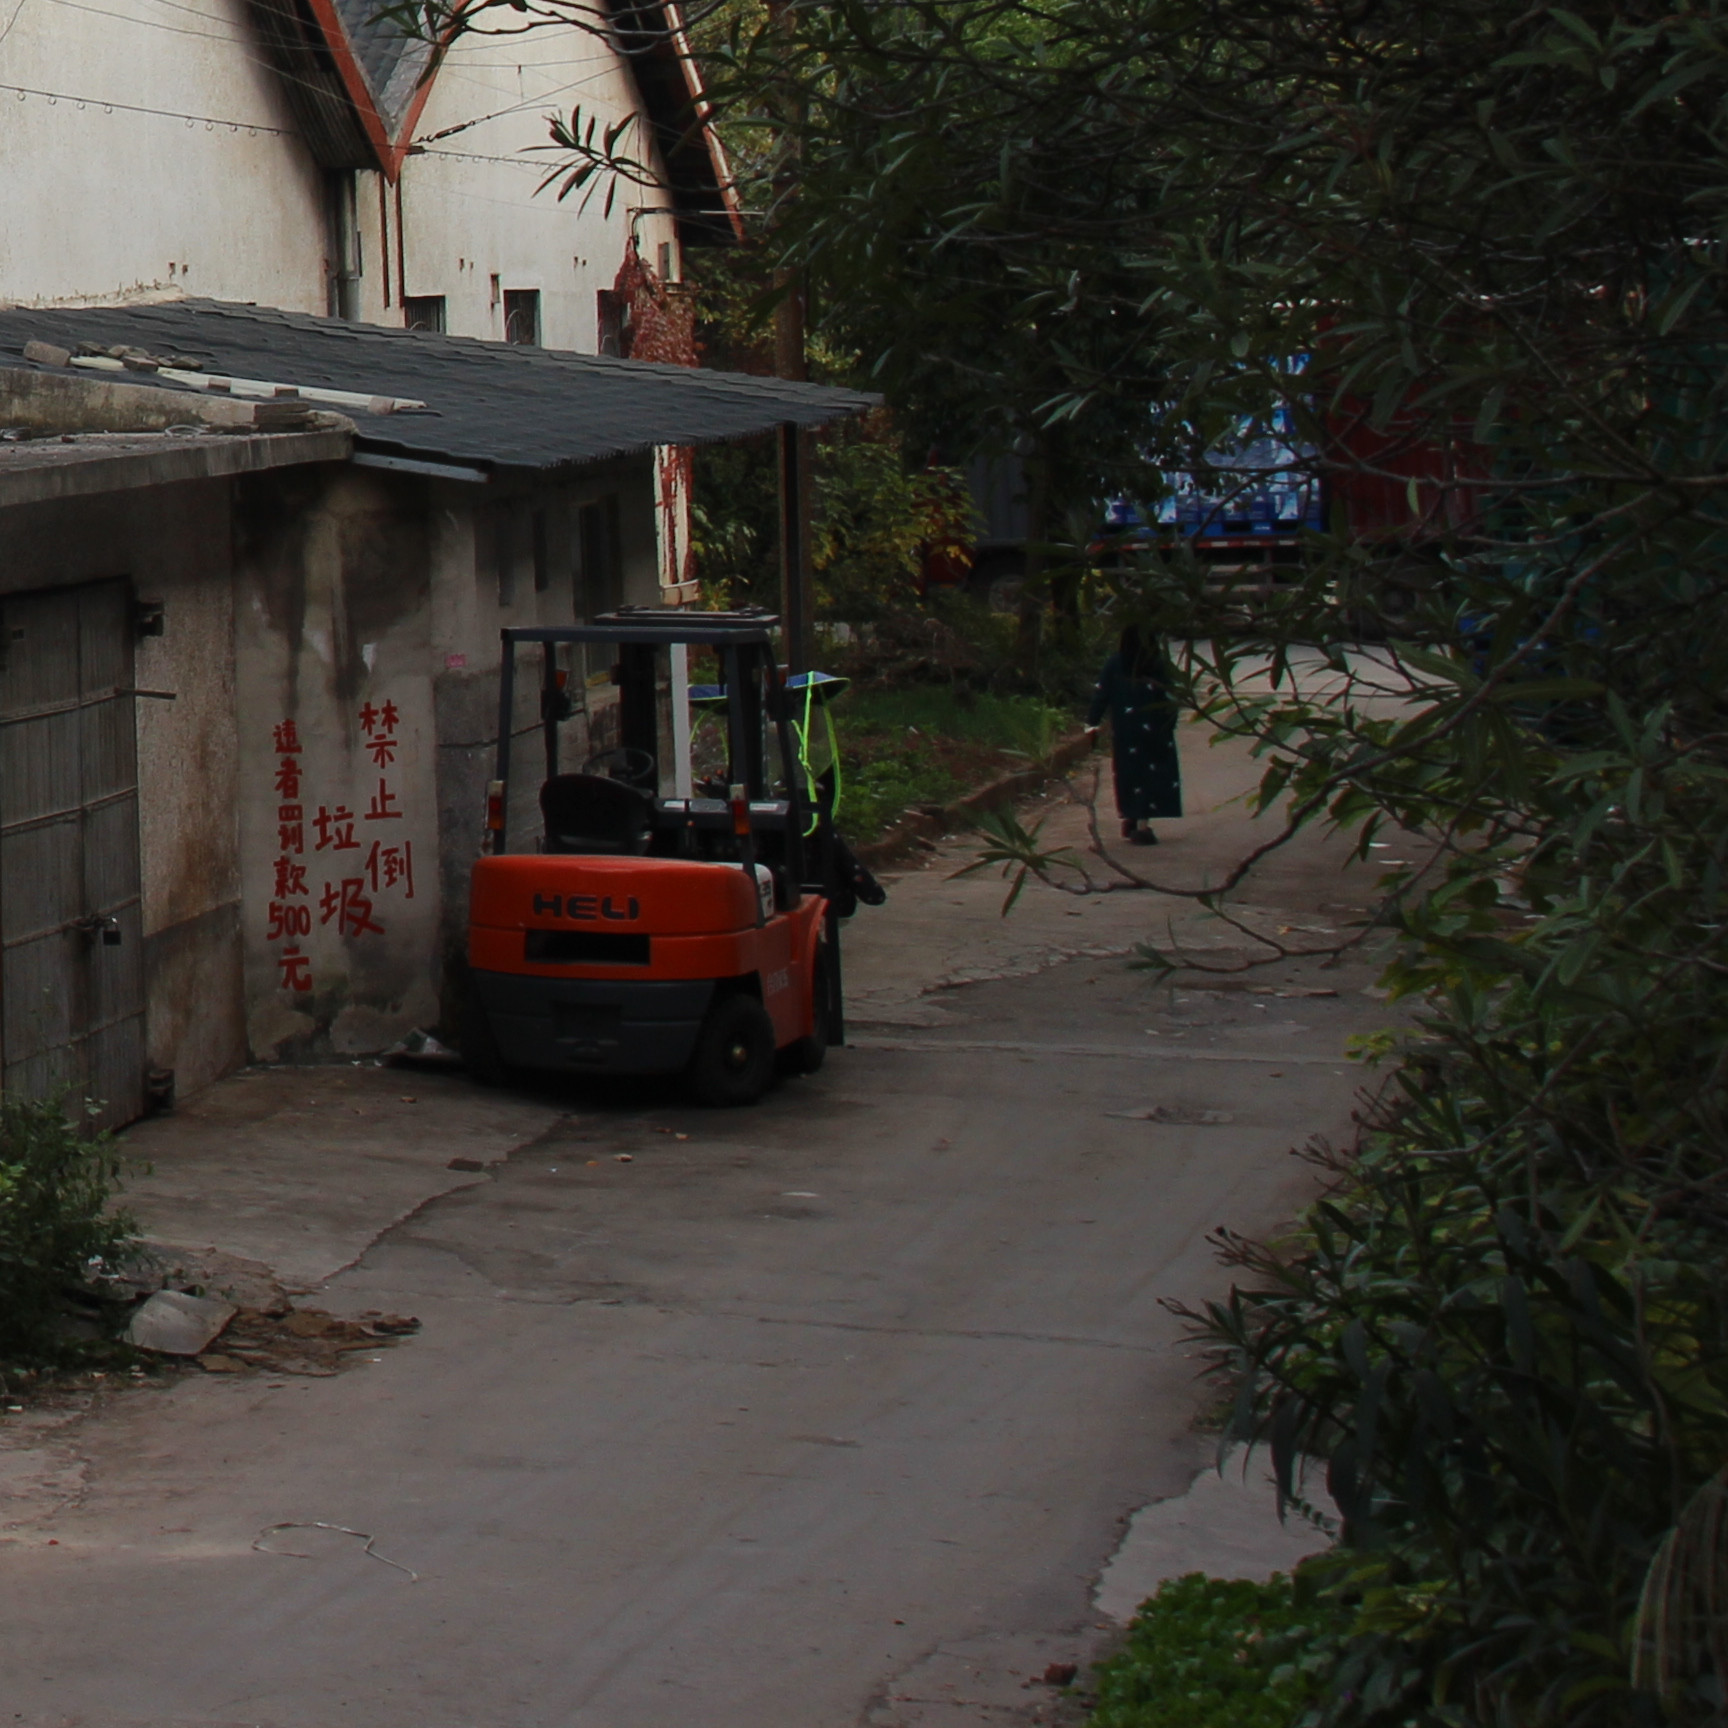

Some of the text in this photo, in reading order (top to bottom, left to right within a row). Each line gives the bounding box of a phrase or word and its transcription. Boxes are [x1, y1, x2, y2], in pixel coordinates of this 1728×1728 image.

[359, 699, 414, 898] 禁止倒
[312, 804, 385, 938] 垃圾
[533, 893, 640, 921] HELI
